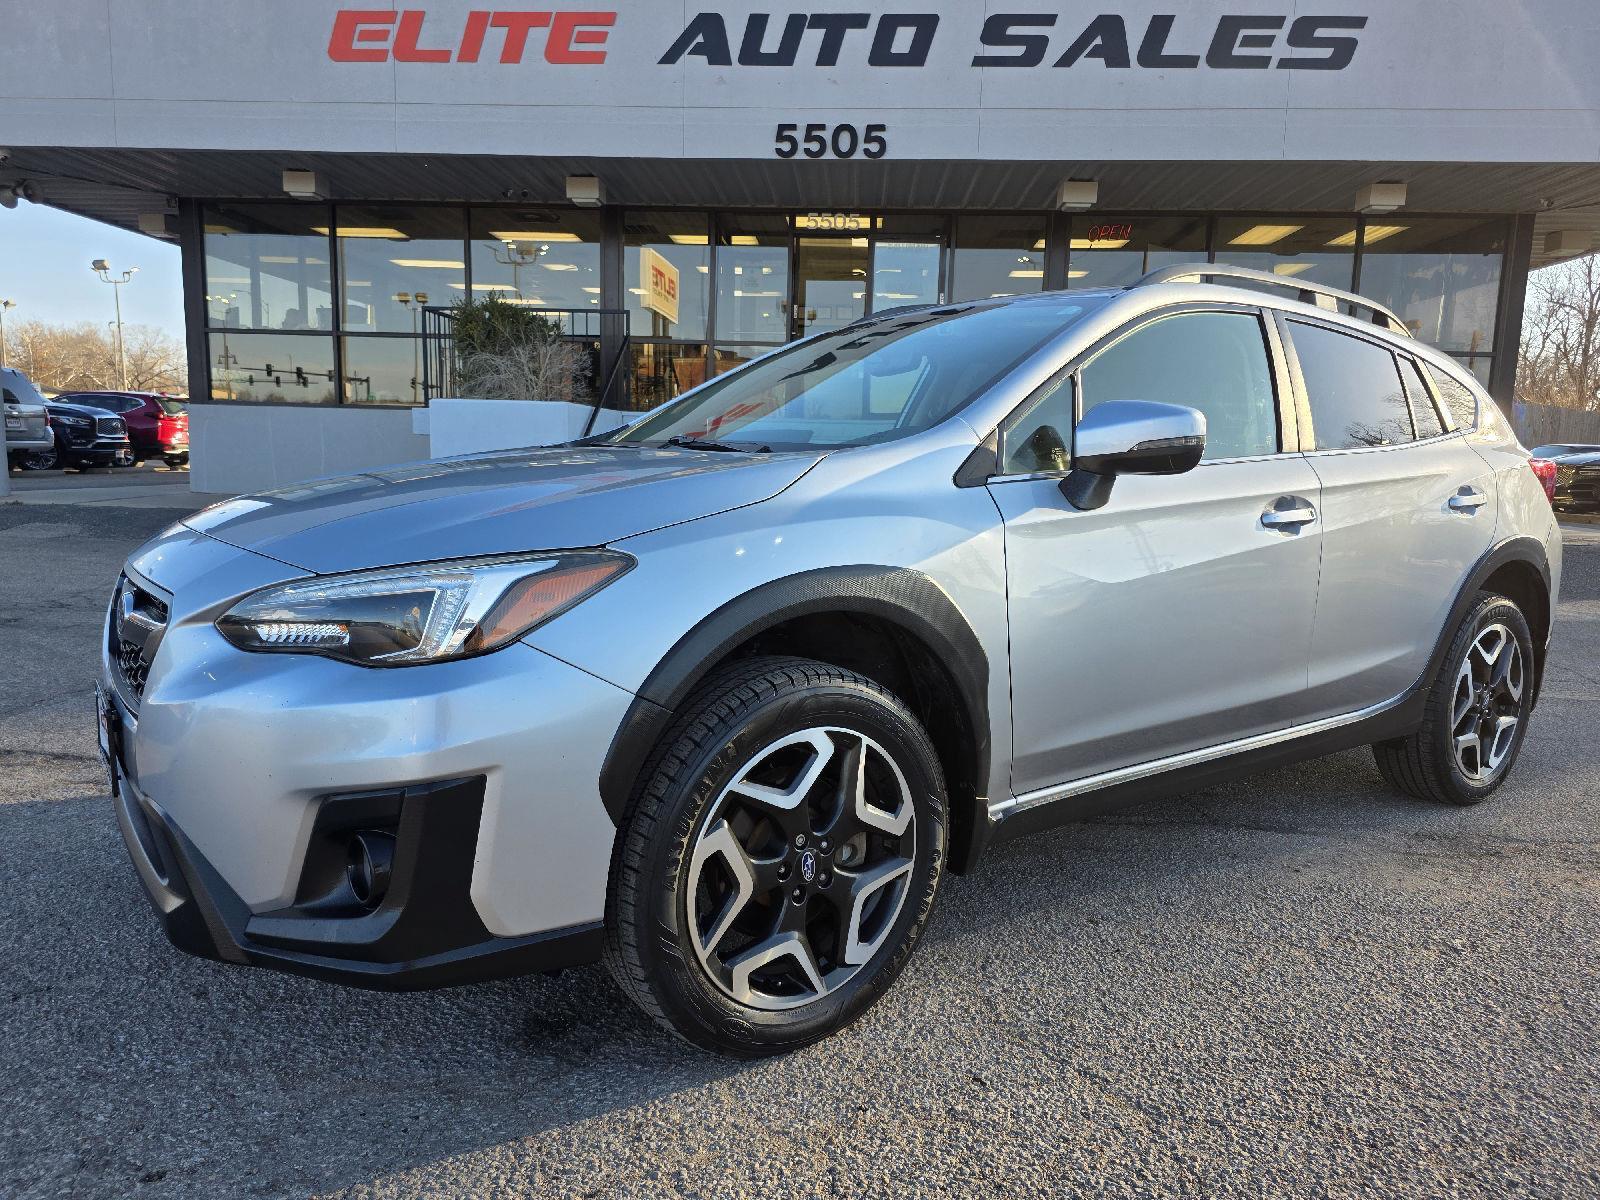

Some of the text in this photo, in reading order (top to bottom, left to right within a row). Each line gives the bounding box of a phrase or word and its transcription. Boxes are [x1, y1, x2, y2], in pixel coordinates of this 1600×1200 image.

[328, 10, 1367, 69] ELITE AUTO SALES
[775, 123, 887, 160] 5505
[806, 212, 861, 231] 5505
[1088, 223, 1133, 242] OPEN
